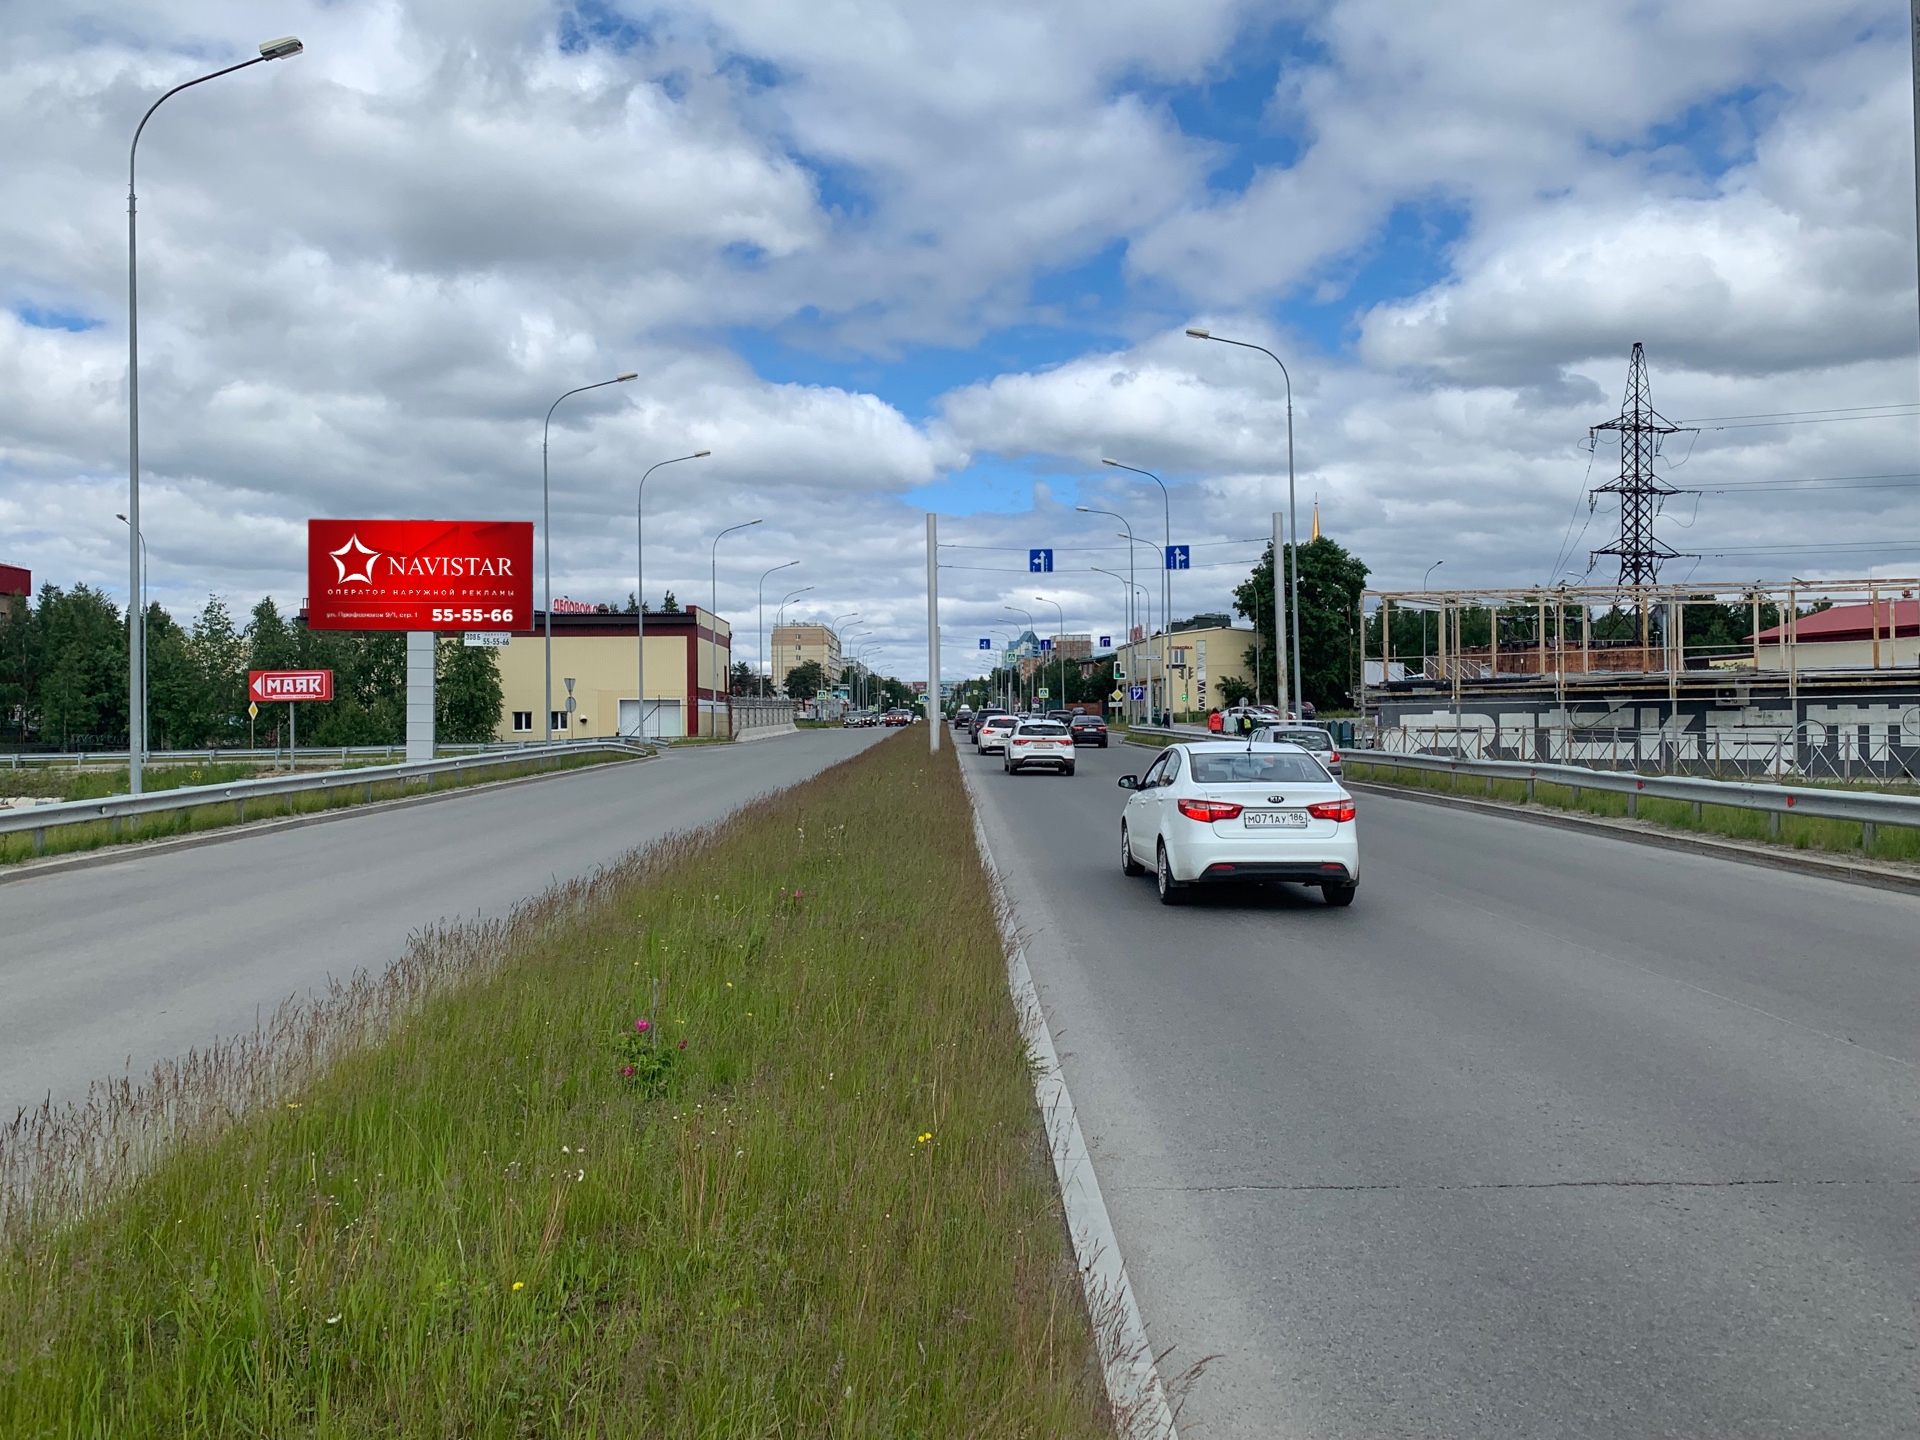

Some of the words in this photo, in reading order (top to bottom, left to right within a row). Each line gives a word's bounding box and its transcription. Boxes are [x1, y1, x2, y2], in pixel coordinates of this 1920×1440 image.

[387, 556, 514, 577] NAVISTAR
[327, 588, 386, 596] ОПЕРАТОР
[393, 588, 455, 597] НАРУЖНОЙ
[462, 589, 515, 597] РЕКЛАМЫ
[552, 598, 591, 613] ДЕЛОВОЙ
[431, 608, 514, 622] 55-55-66
[482, 637, 510, 646] 55-55-66
[266, 678, 322, 693] МАЯК
[1289, 813, 1304, 821] 186
